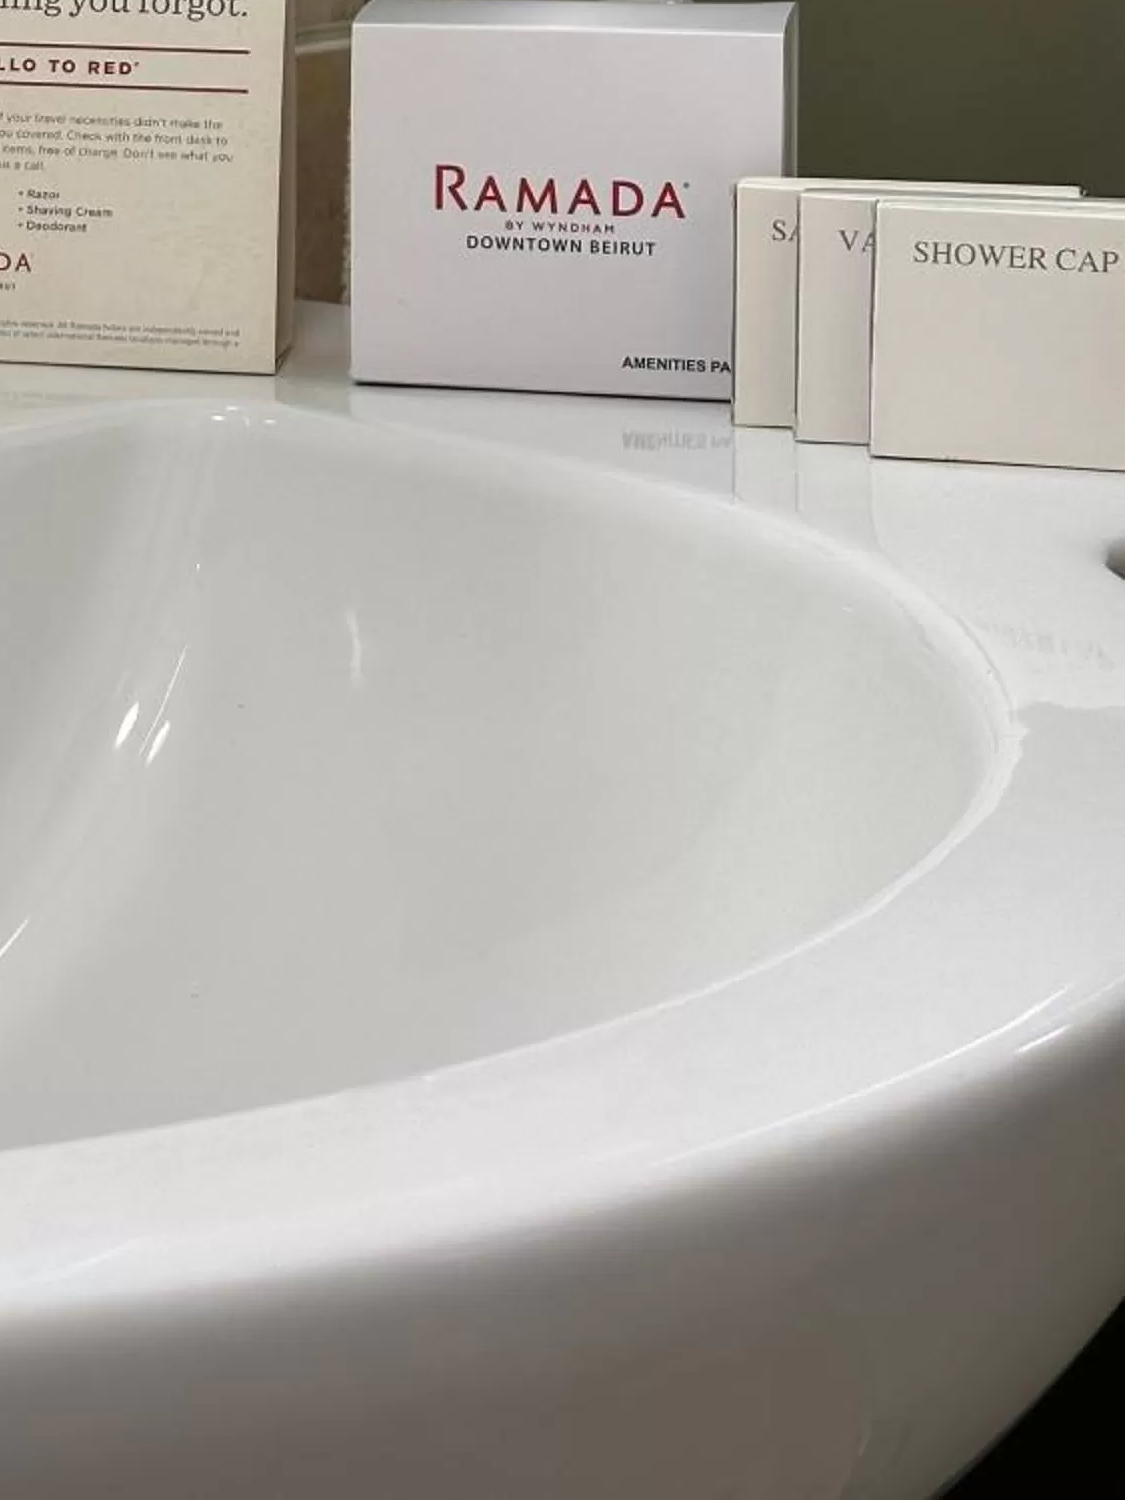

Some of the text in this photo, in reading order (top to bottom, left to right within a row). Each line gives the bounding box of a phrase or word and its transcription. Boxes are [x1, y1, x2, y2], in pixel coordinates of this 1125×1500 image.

[49, 59, 76, 73] TO
[27, 190, 60, 200] Razor
[435, 164, 686, 219] RAMADA
[27, 205, 113, 218] Shaving Cream
[26, 220, 87, 232] Deodorant
[505, 219, 615, 234] BY WYNDHAM
[466, 235, 656, 257] DOWNTOWN BEIRUT
[913, 240, 1120, 273] SHOWER CAP
[622, 356, 706, 373] AMENITIES
